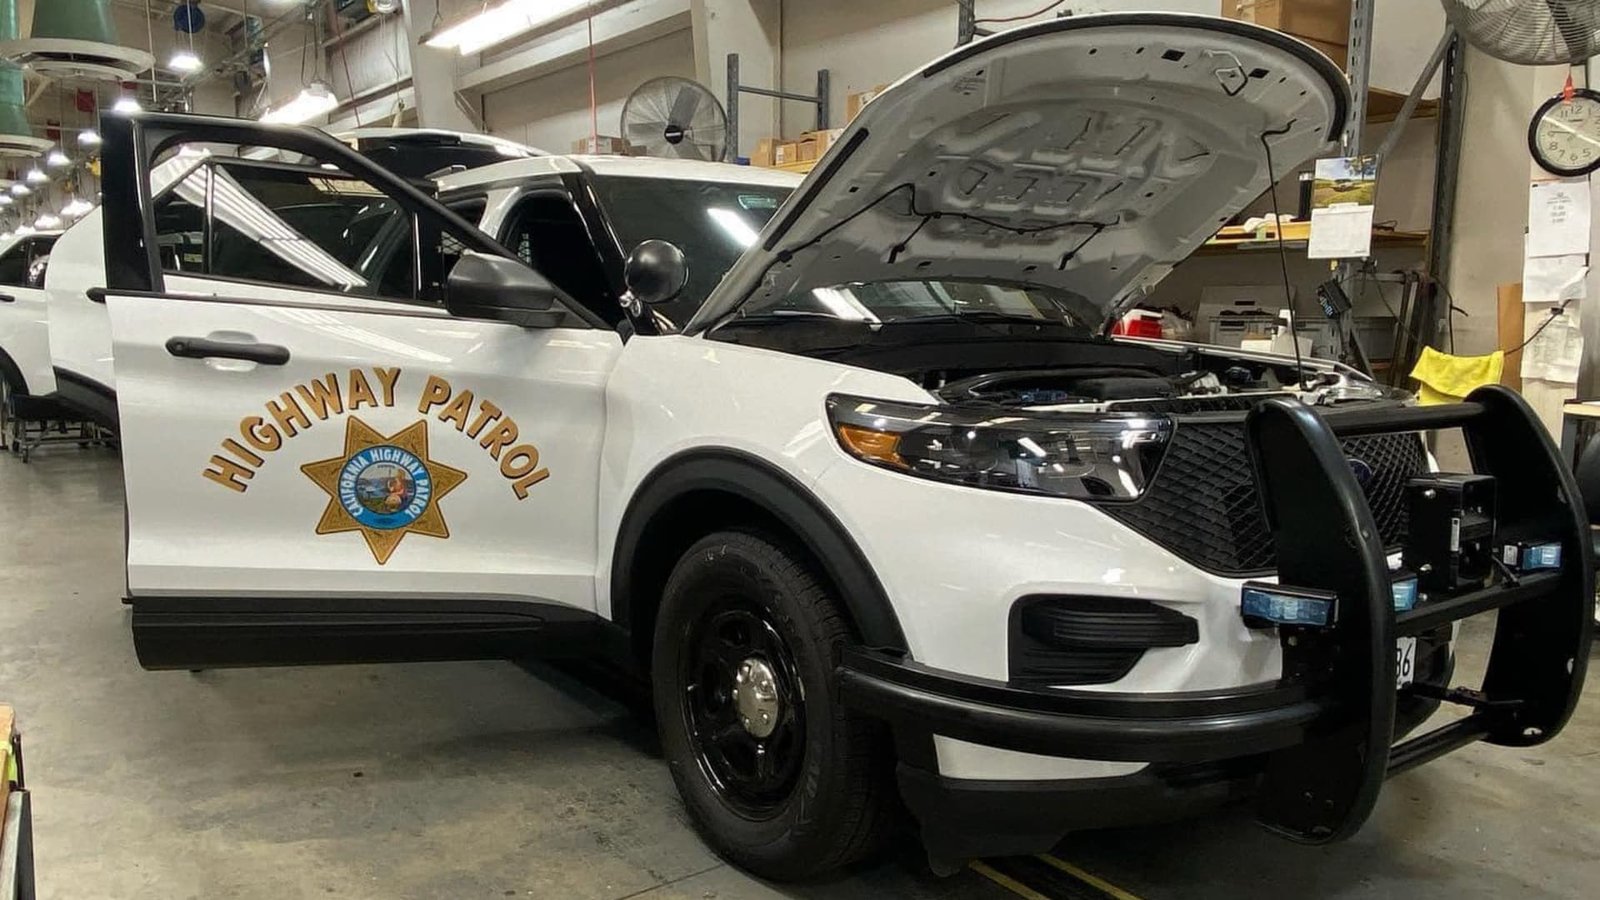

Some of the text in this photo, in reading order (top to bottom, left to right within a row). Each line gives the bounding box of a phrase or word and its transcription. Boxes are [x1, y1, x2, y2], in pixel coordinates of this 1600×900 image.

[1570, 105, 1583, 114] 12
[1548, 141, 1558, 151] 8
[1559, 149, 1566, 158] 7
[1582, 147, 1592, 158] 5
[202, 368, 550, 501] HIGHWAY PATROL
[340, 448, 429, 519] CALIFORNIA HIGHWAY PATROL
